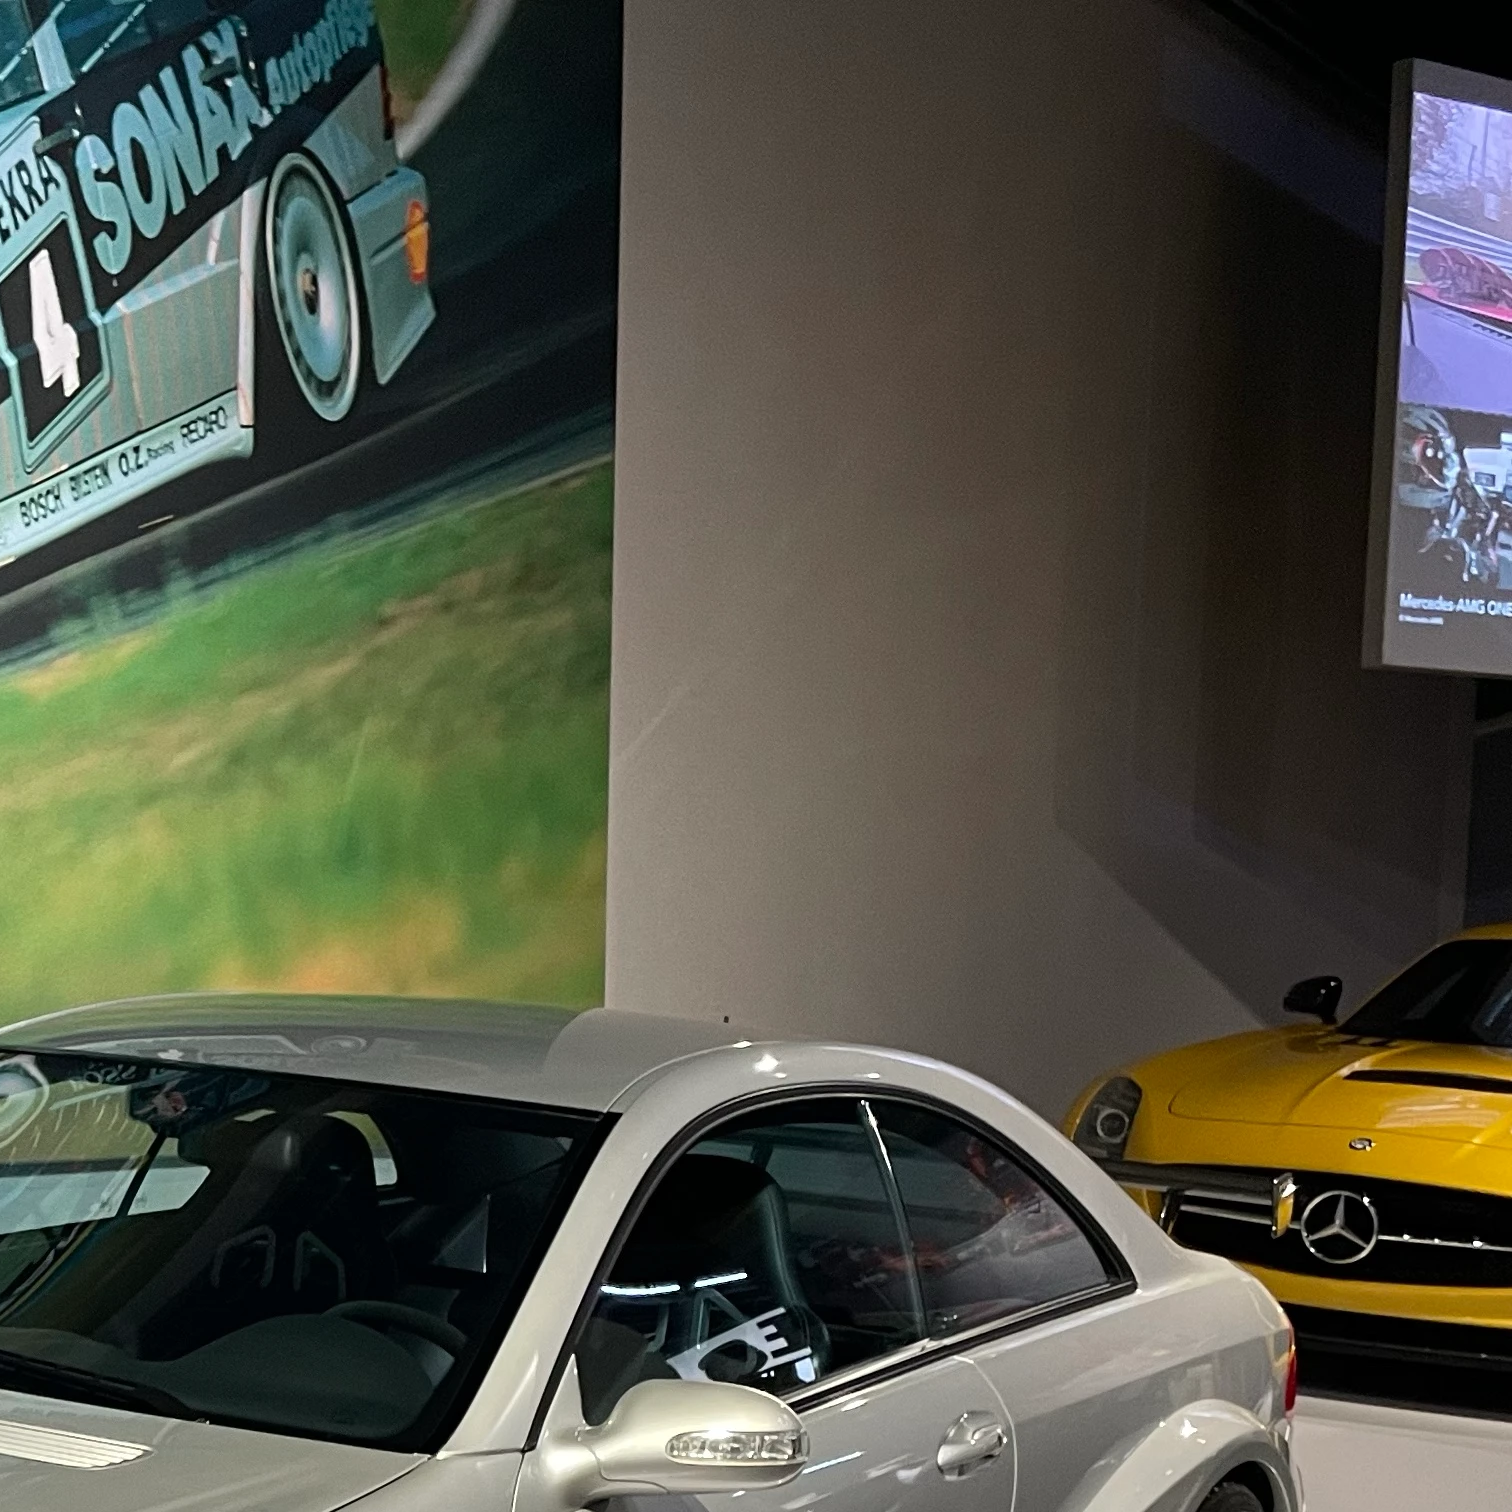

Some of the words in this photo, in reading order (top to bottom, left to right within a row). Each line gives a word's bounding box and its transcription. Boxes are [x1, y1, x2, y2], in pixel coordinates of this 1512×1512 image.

[75, 15, 274, 275] SONAX
[28, 248, 81, 398] 4
[19, 482, 65, 527] BOSCH
[180, 405, 228, 448] RECARO
